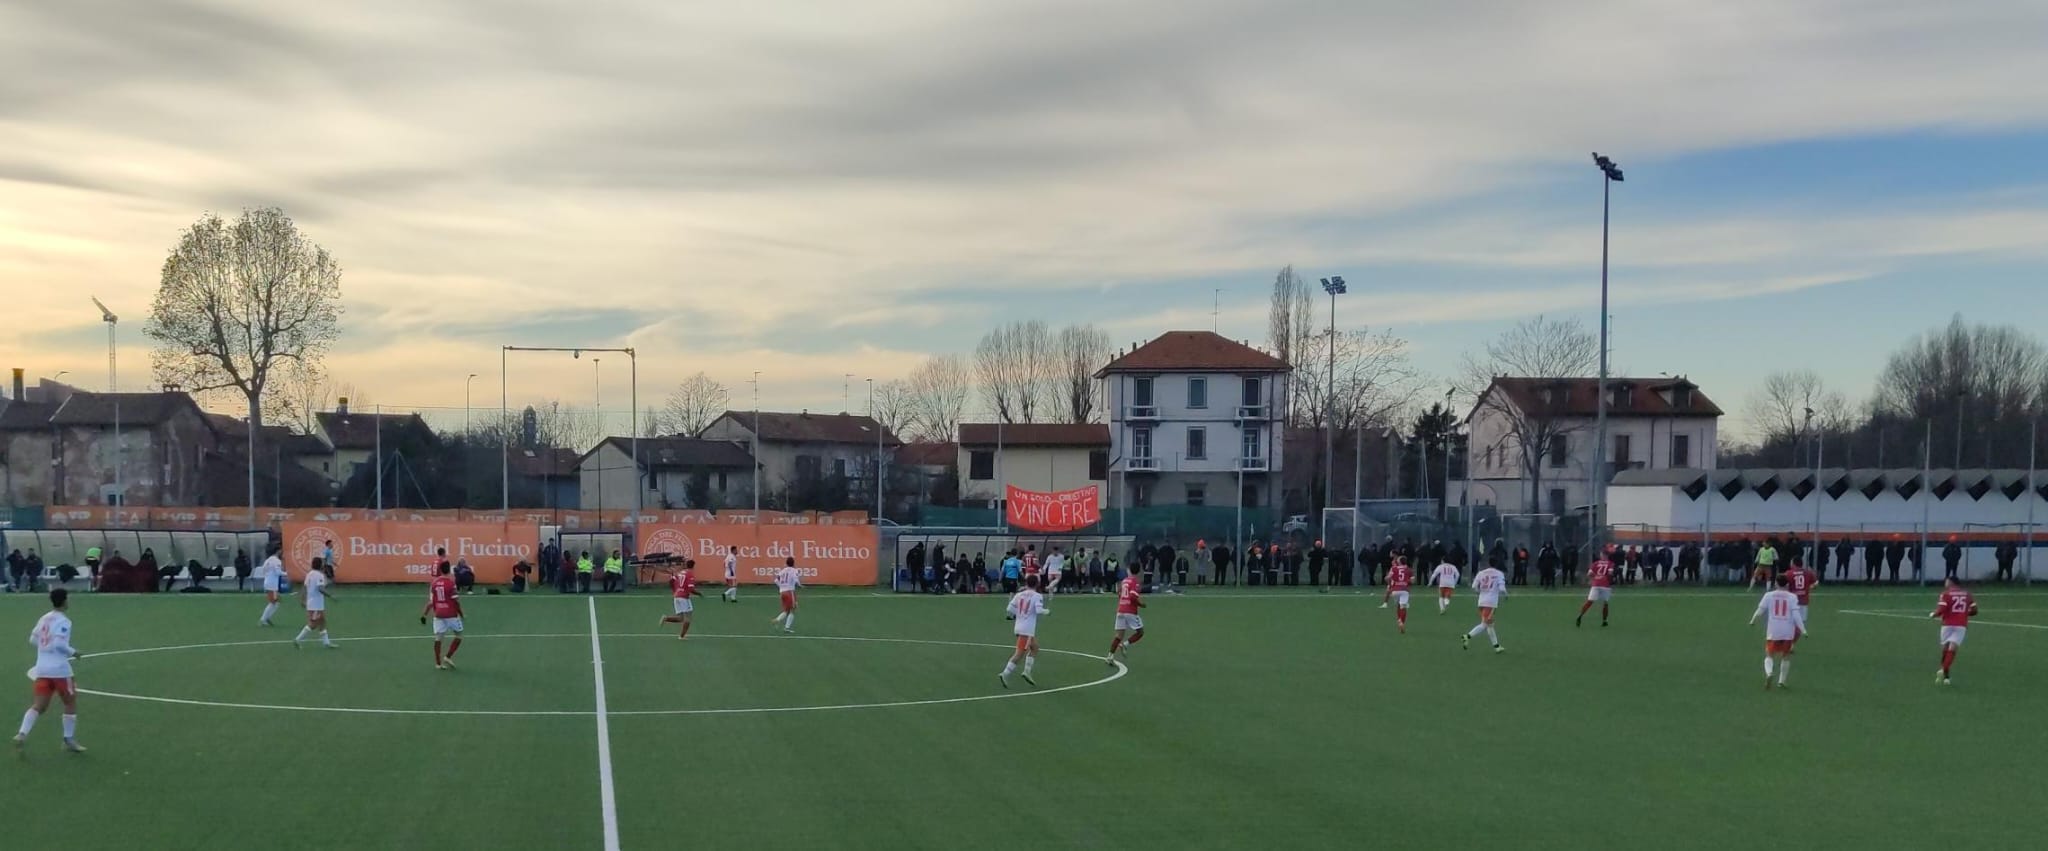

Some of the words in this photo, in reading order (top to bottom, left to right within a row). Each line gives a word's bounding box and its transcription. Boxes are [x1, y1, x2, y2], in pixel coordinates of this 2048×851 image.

[350, 536, 414, 556] Banca
[459, 539, 530, 558] Fucino
[766, 541, 795, 559] del
[801, 540, 870, 560] Fucino
[1398, 568, 1405, 581] 5
[1597, 563, 1609, 576] 27
[1774, 599, 1788, 617] 11
[1951, 596, 1967, 613] 25
